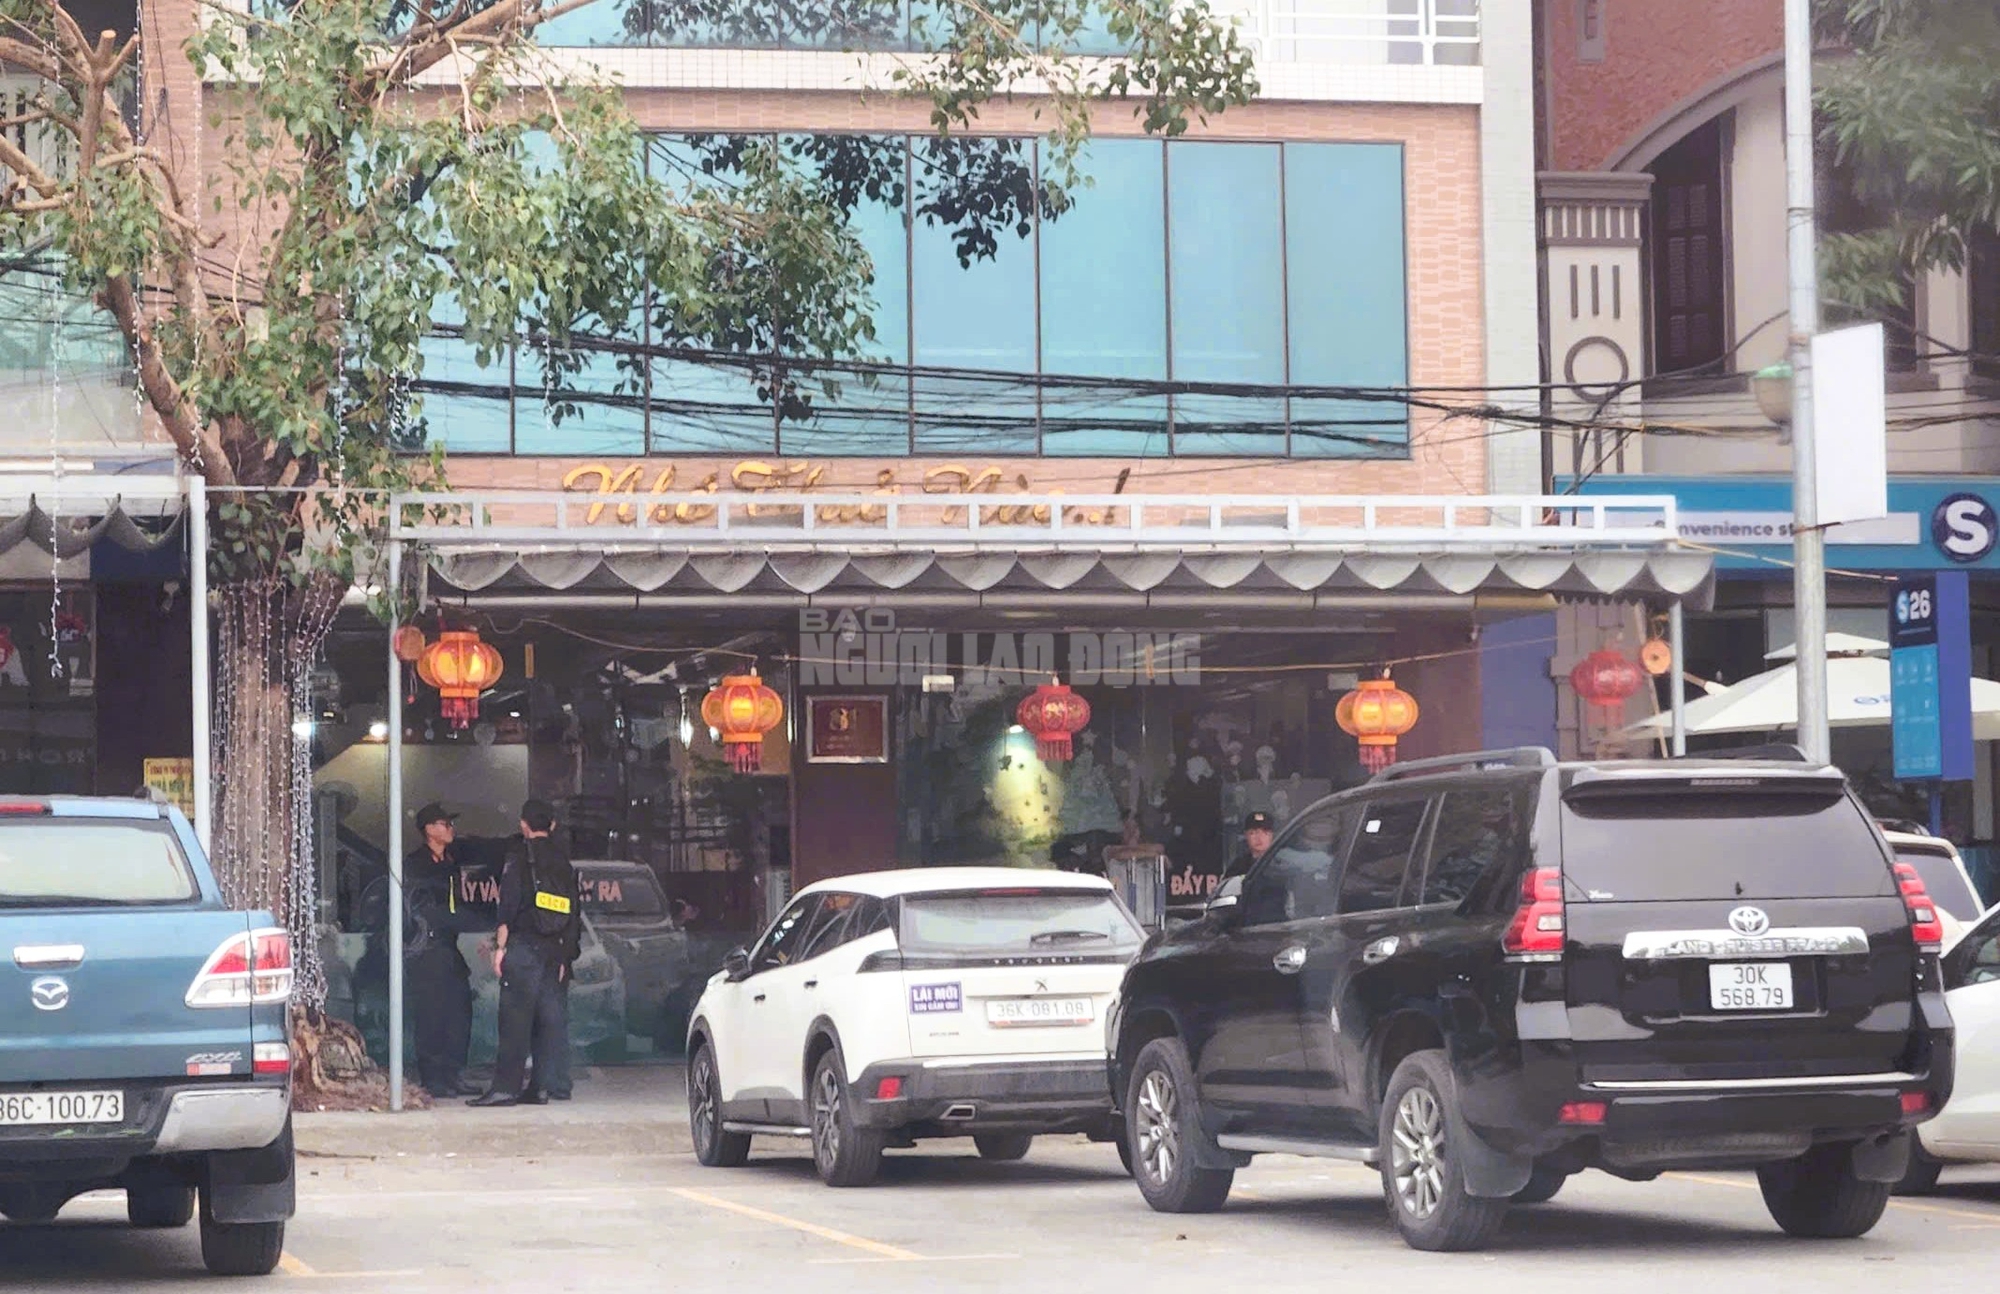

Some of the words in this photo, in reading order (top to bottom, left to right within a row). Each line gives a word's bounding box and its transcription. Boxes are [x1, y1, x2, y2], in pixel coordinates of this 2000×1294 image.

[1655, 519, 1774, 537] nvenience
[1944, 499, 1990, 554] S
[1909, 589, 1931, 620] 26
[598, 880, 622, 902] RA
[1733, 966, 1768, 985] 30K
[1720, 987, 1784, 1007] 568.79
